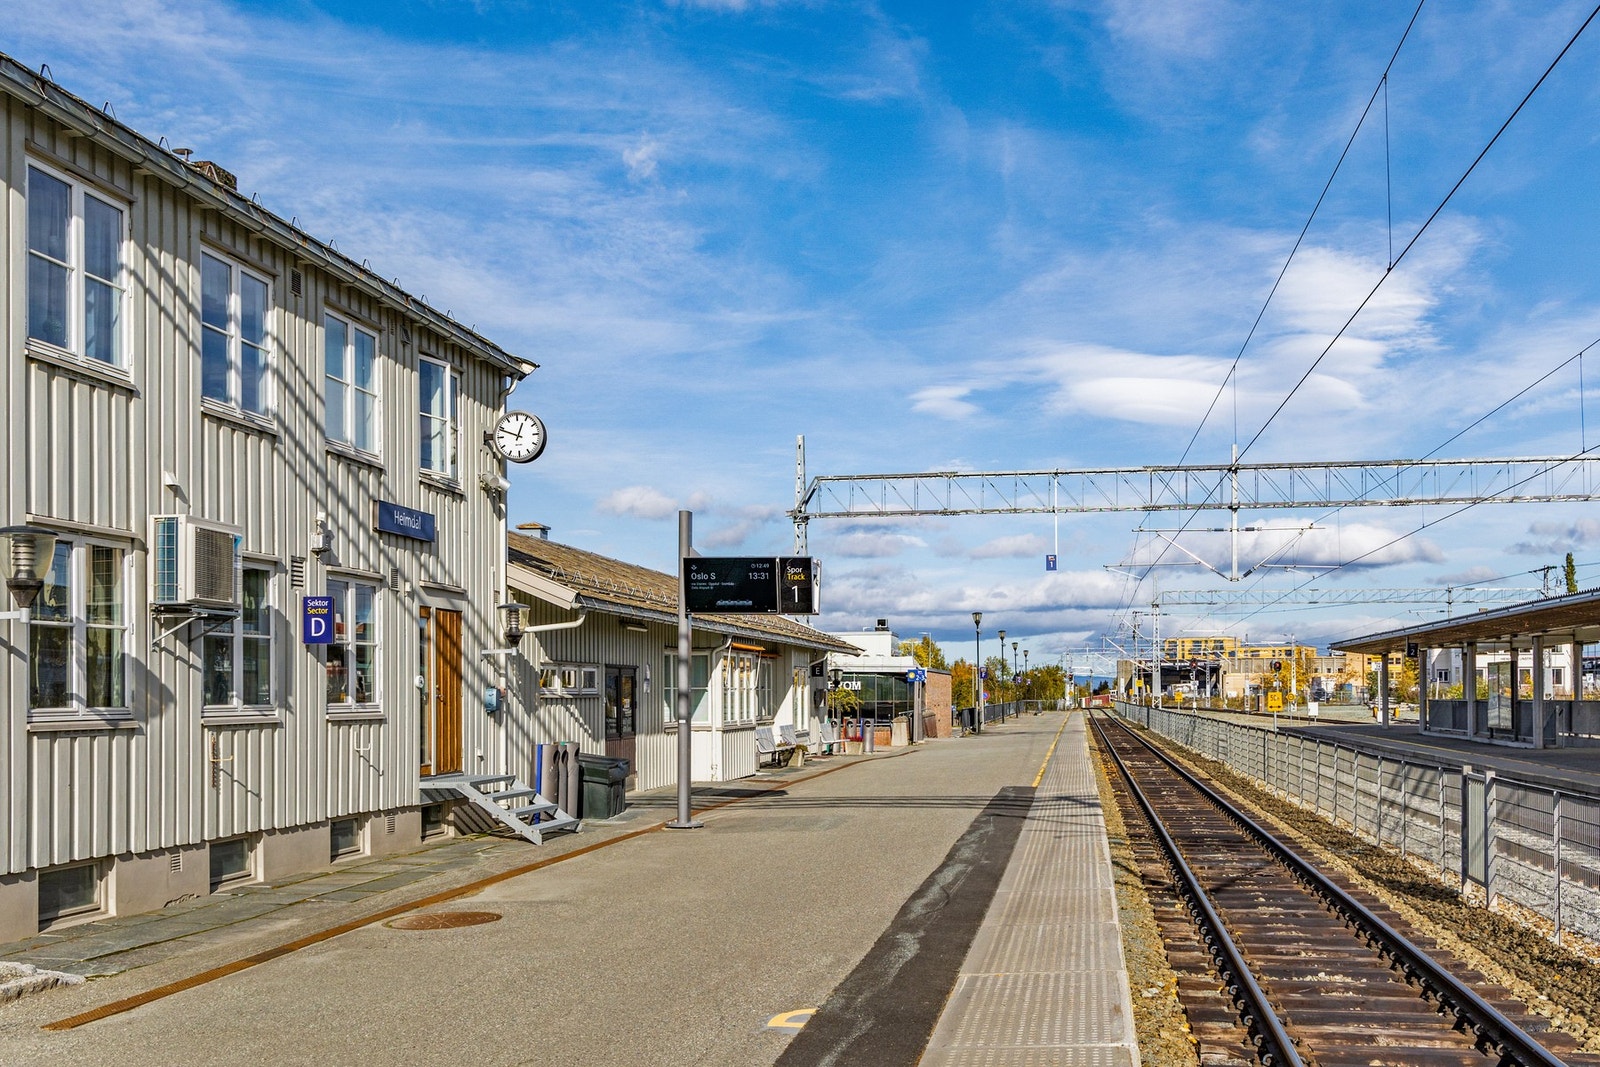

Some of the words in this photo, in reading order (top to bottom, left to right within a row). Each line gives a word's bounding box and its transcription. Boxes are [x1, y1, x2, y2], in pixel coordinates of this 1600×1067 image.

[393, 510, 422, 530] Heimdal
[786, 566, 803, 574] Spor
[690, 572, 709, 580] Oslo
[710, 572, 716, 580] S
[748, 572, 769, 580] 13:31
[787, 573, 805, 581] Track
[791, 585, 798, 603] 1
[307, 599, 329, 607] Sektor
[307, 607, 329, 615] Sector
[311, 617, 326, 637] D
[815, 667, 821, 675] E
